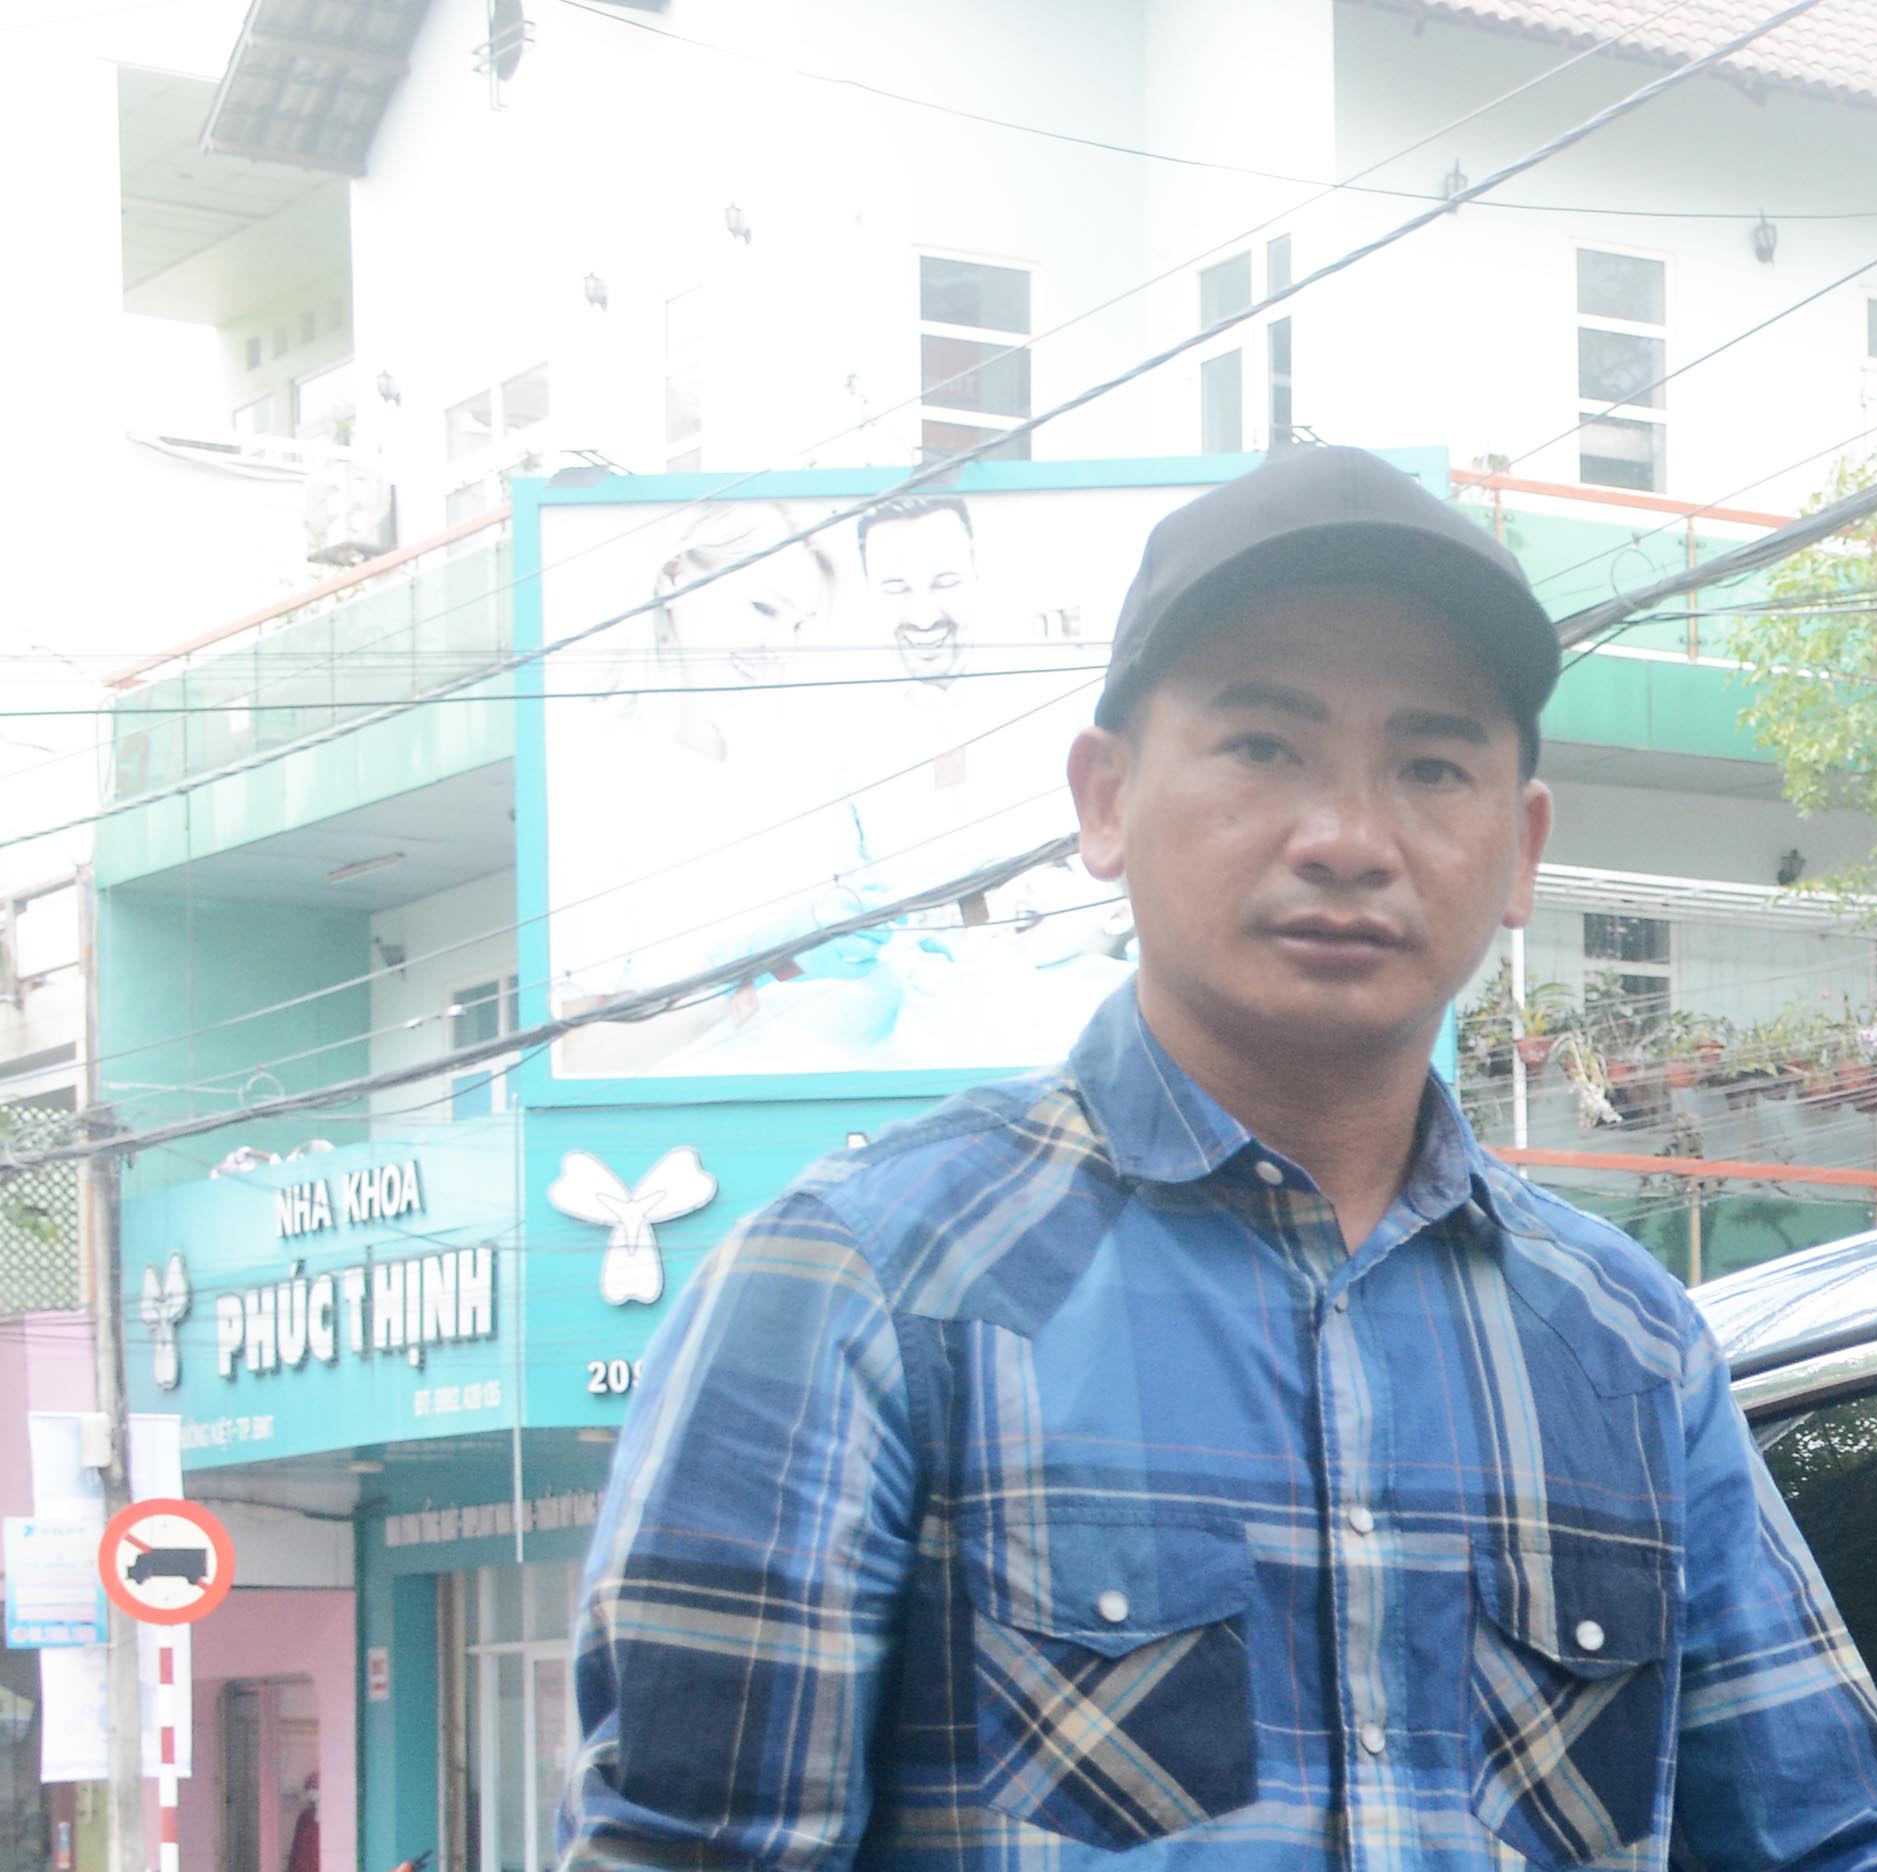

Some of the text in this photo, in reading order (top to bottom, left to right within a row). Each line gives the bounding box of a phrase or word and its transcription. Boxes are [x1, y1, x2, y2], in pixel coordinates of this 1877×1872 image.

[275, 1159, 421, 1238] NHA KHOA
[215, 1247, 493, 1377] PHÚC THỊNH
